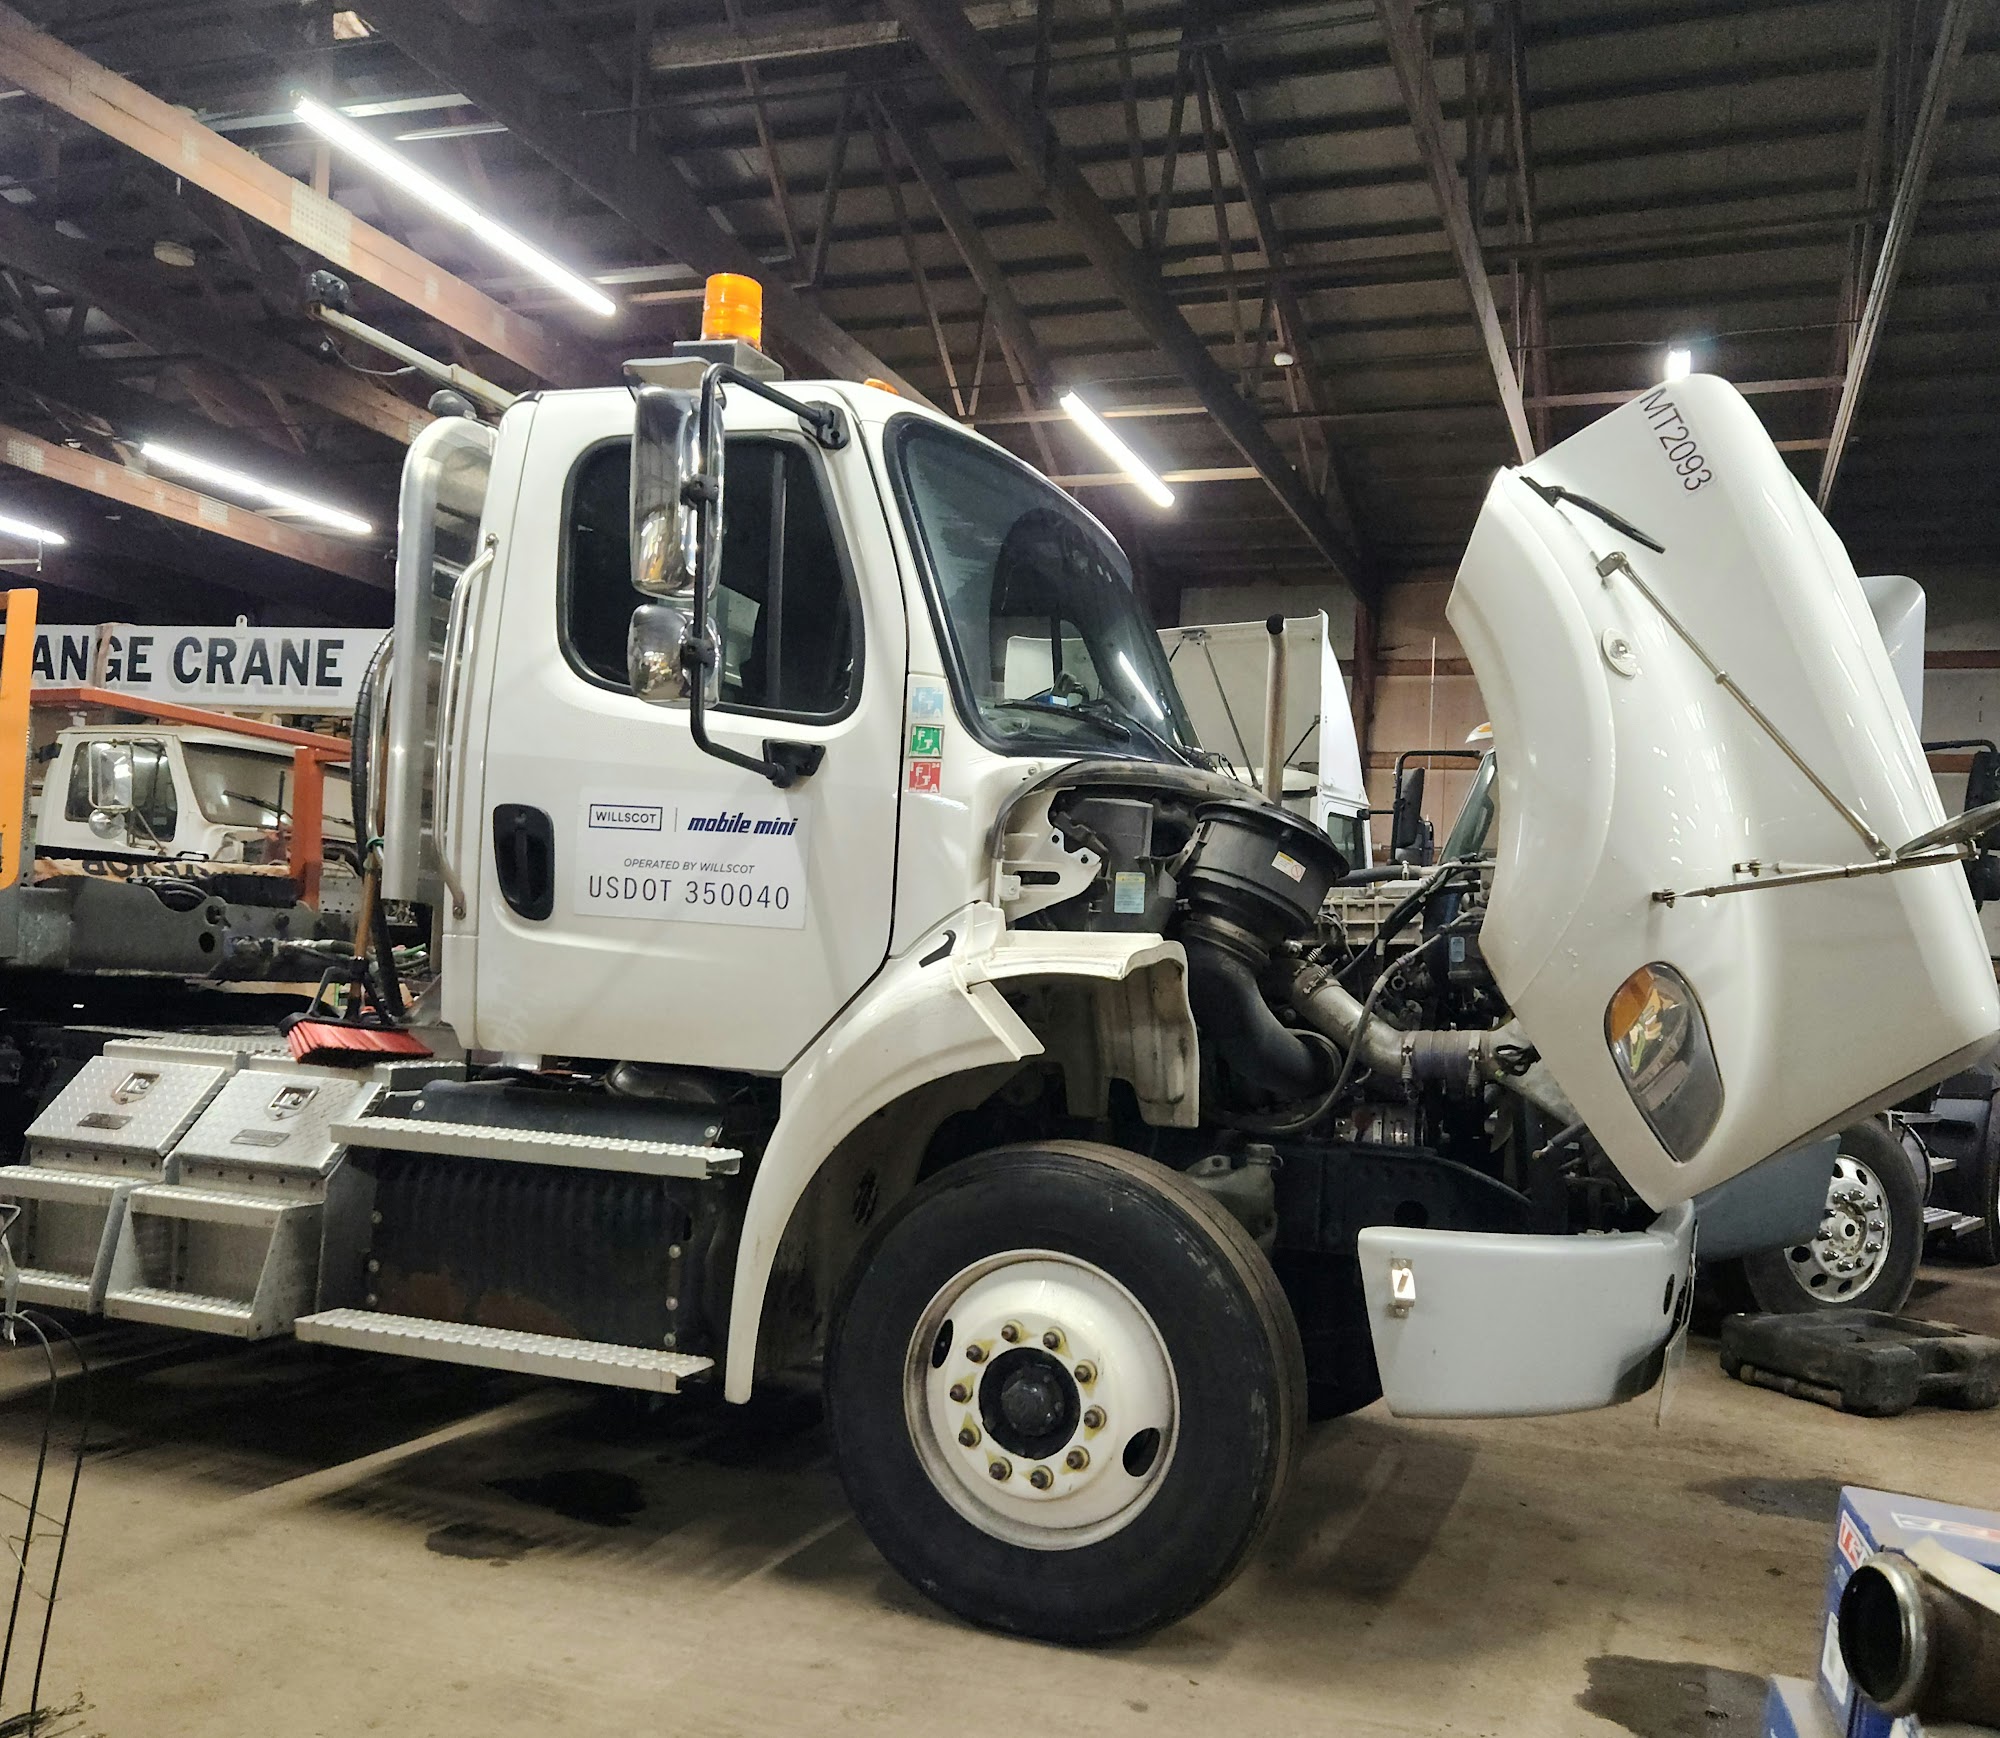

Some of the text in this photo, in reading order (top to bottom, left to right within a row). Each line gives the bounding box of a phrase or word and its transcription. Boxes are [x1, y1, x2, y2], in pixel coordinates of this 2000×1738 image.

[1639, 387, 1712, 491] MT2093
[172, 636, 344, 688] CRANE
[595, 811, 657, 824] WILLSCOT
[687, 811, 799, 836] mobile mini
[623, 857, 756, 875] OPERATED BY WILLSCOT
[589, 875, 790, 910] USDOT 350040
